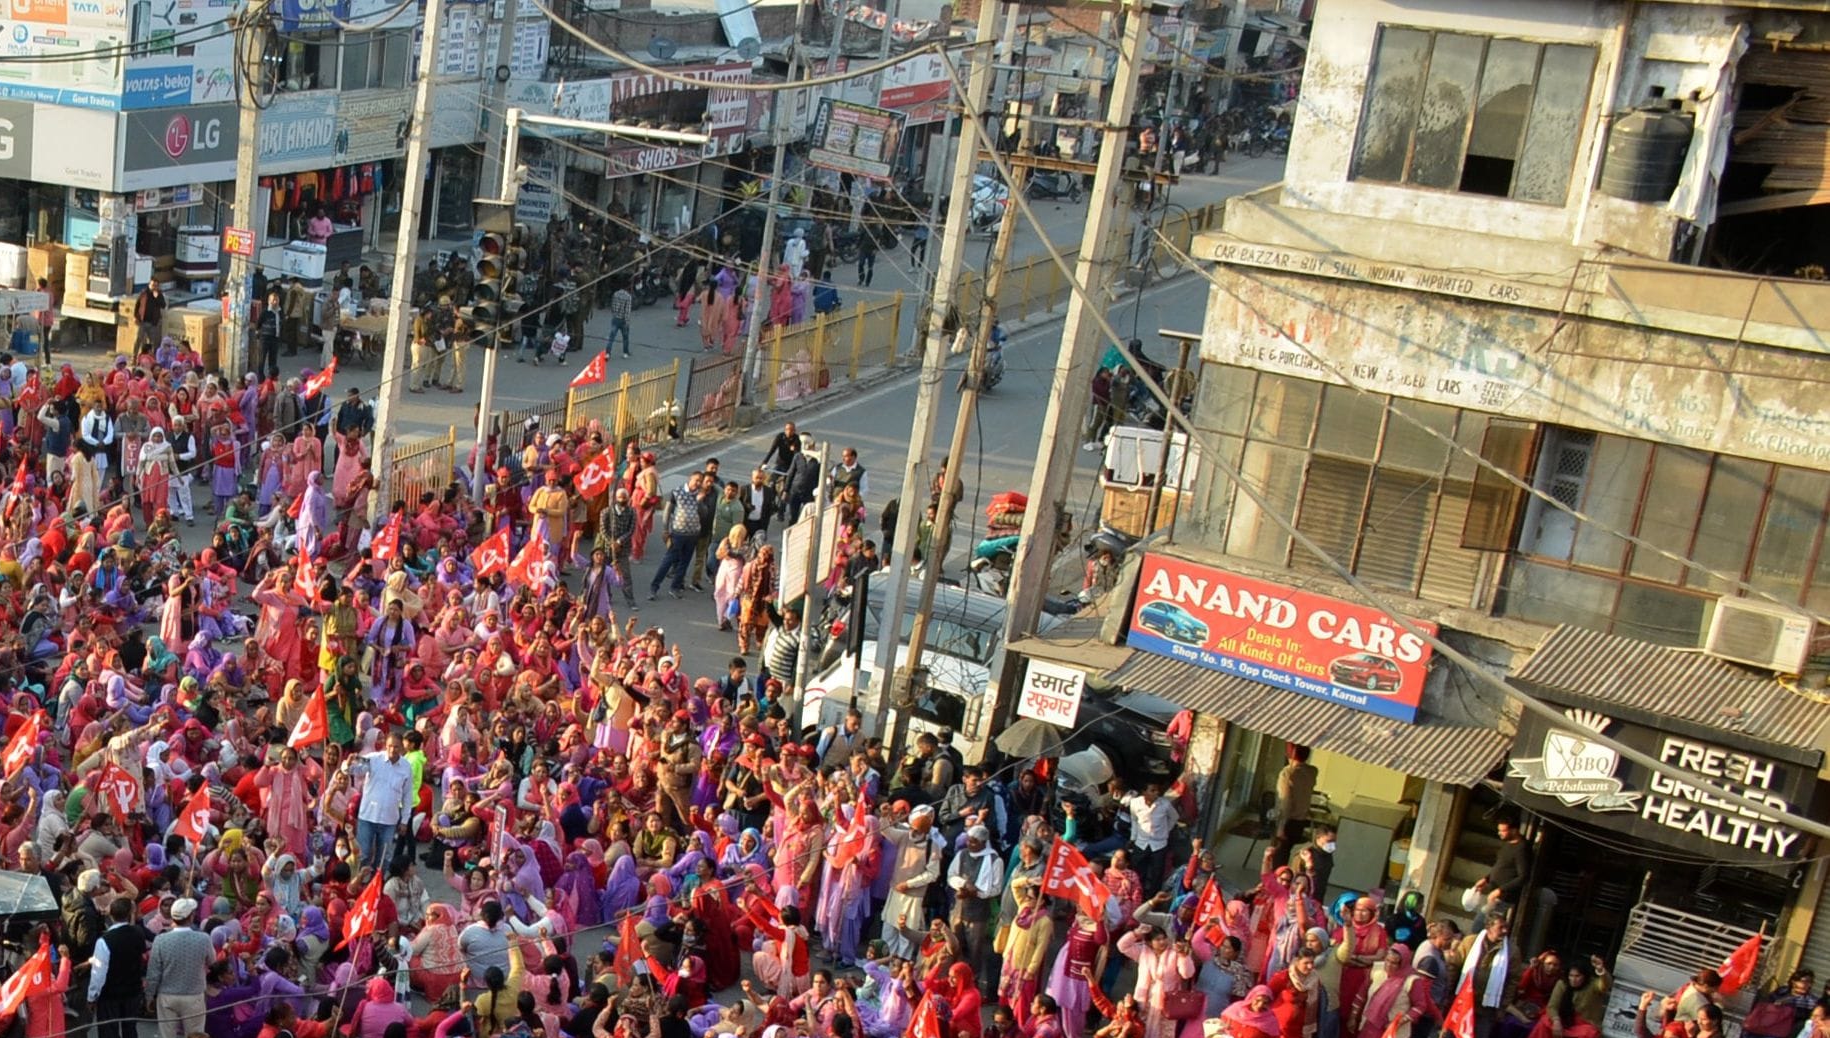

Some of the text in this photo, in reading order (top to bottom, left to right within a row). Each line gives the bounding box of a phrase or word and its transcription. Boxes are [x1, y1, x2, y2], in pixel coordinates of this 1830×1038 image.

[74, 2, 100, 14] TATA
[90, 95, 115, 108] Traders
[193, 119, 220, 150] LG
[286, 118, 332, 149] ANAND
[636, 147, 678, 171] SHOES
[225, 231, 239, 251] PG
[1300, 256, 1323, 272] BUY
[1488, 283, 1521, 301] CARS
[1352, 364, 1379, 381] NEW
[1436, 378, 1462, 395] CARS
[126, 443, 138, 473] CITU
[1143, 567, 1426, 664] ANAND CARS
[1247, 626, 1302, 655] Deals In:
[1218, 636, 1326, 678] All Kinds Of Cars
[1031, 669, 1079, 700] स्मार्ट
[1172, 643, 1199, 662] Shop
[1220, 654, 1236, 672] 95,
[1239, 661, 1260, 679] Opp
[1261, 666, 1292, 687] Clock
[1294, 675, 1330, 697] Tower,
[1331, 685, 1368, 706] Karnal
[1026, 692, 1074, 718] रफूगर
[1571, 752, 1610, 776] BBQ
[1660, 737, 1776, 791] FRESH
[1640, 794, 1800, 858] HEALTHY
